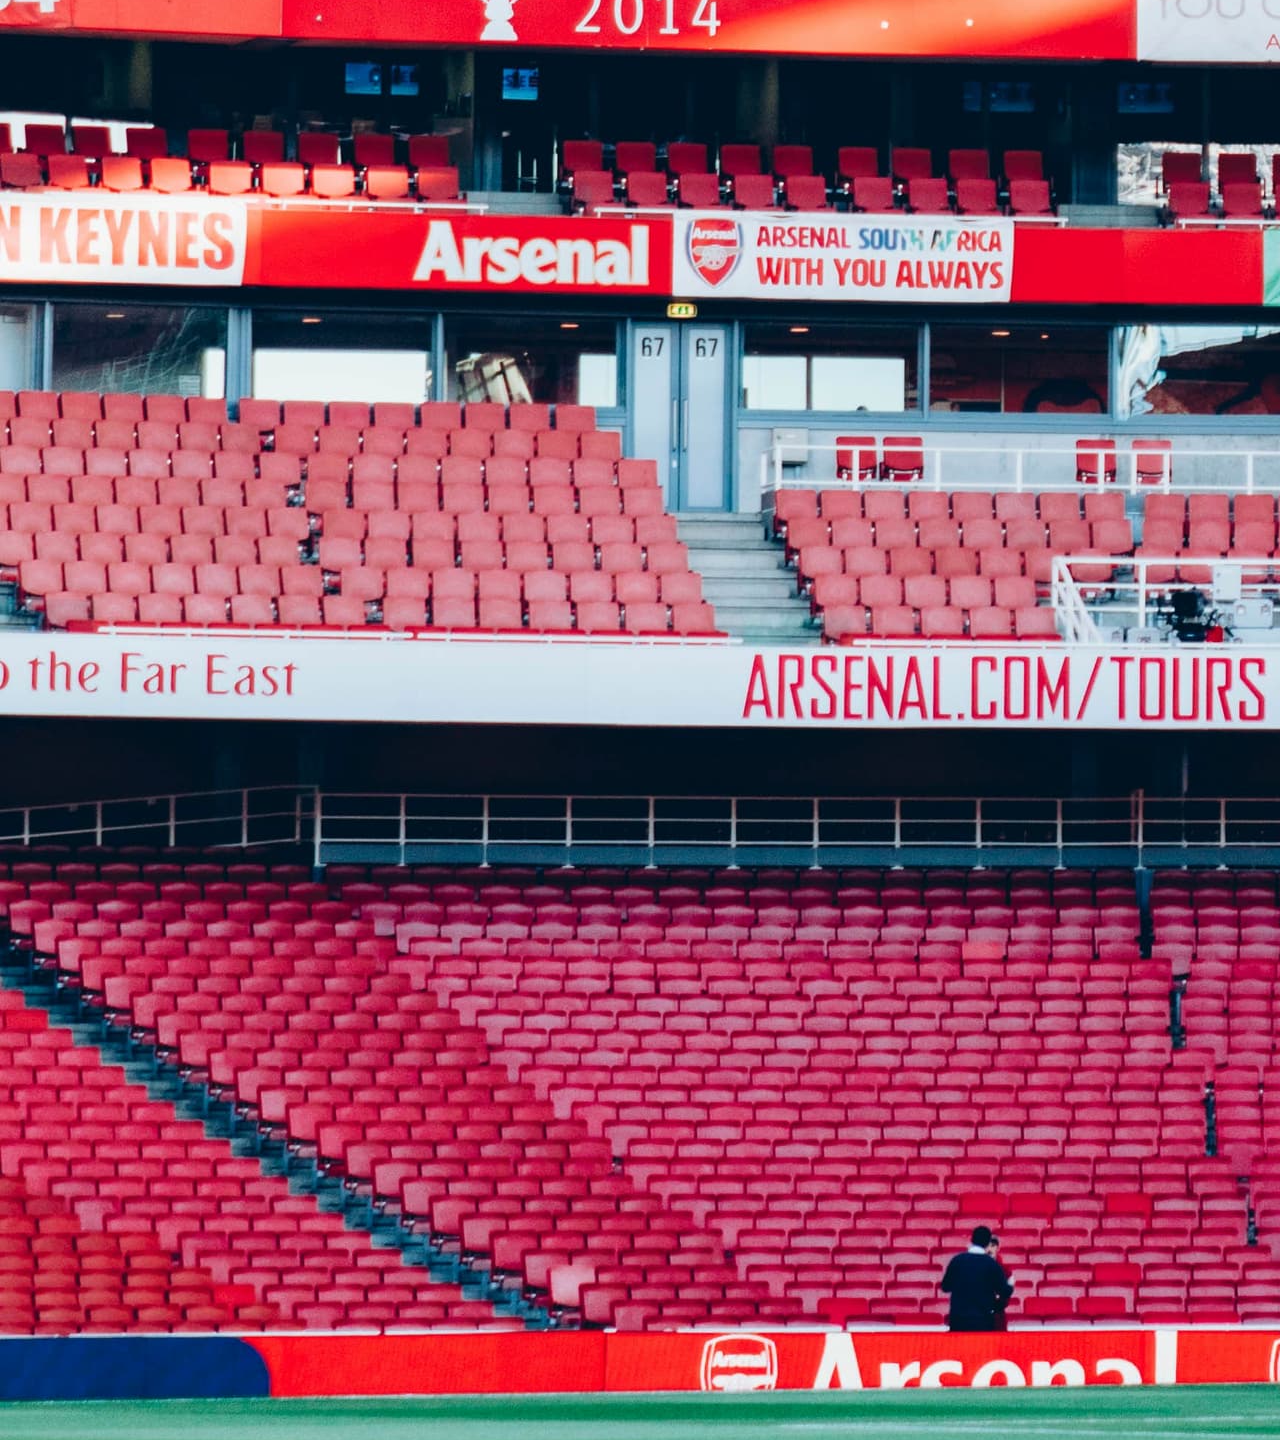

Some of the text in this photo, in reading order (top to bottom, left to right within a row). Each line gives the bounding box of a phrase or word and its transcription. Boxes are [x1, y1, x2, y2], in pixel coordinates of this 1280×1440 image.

[39, 205, 235, 271] KEYNES
[413, 219, 651, 287] Arsenal
[756, 226, 1002, 253] ARSENAL SOUTH AFRICA
[756, 257, 1005, 290] WITH YOU ALWAYS
[641, 337, 664, 357] 67
[695, 337, 718, 357] 67
[28, 651, 100, 693] the
[120, 652, 187, 694] Far
[206, 653, 299, 696] East
[744, 654, 1267, 722] ARSENAL.COM/TOURS
